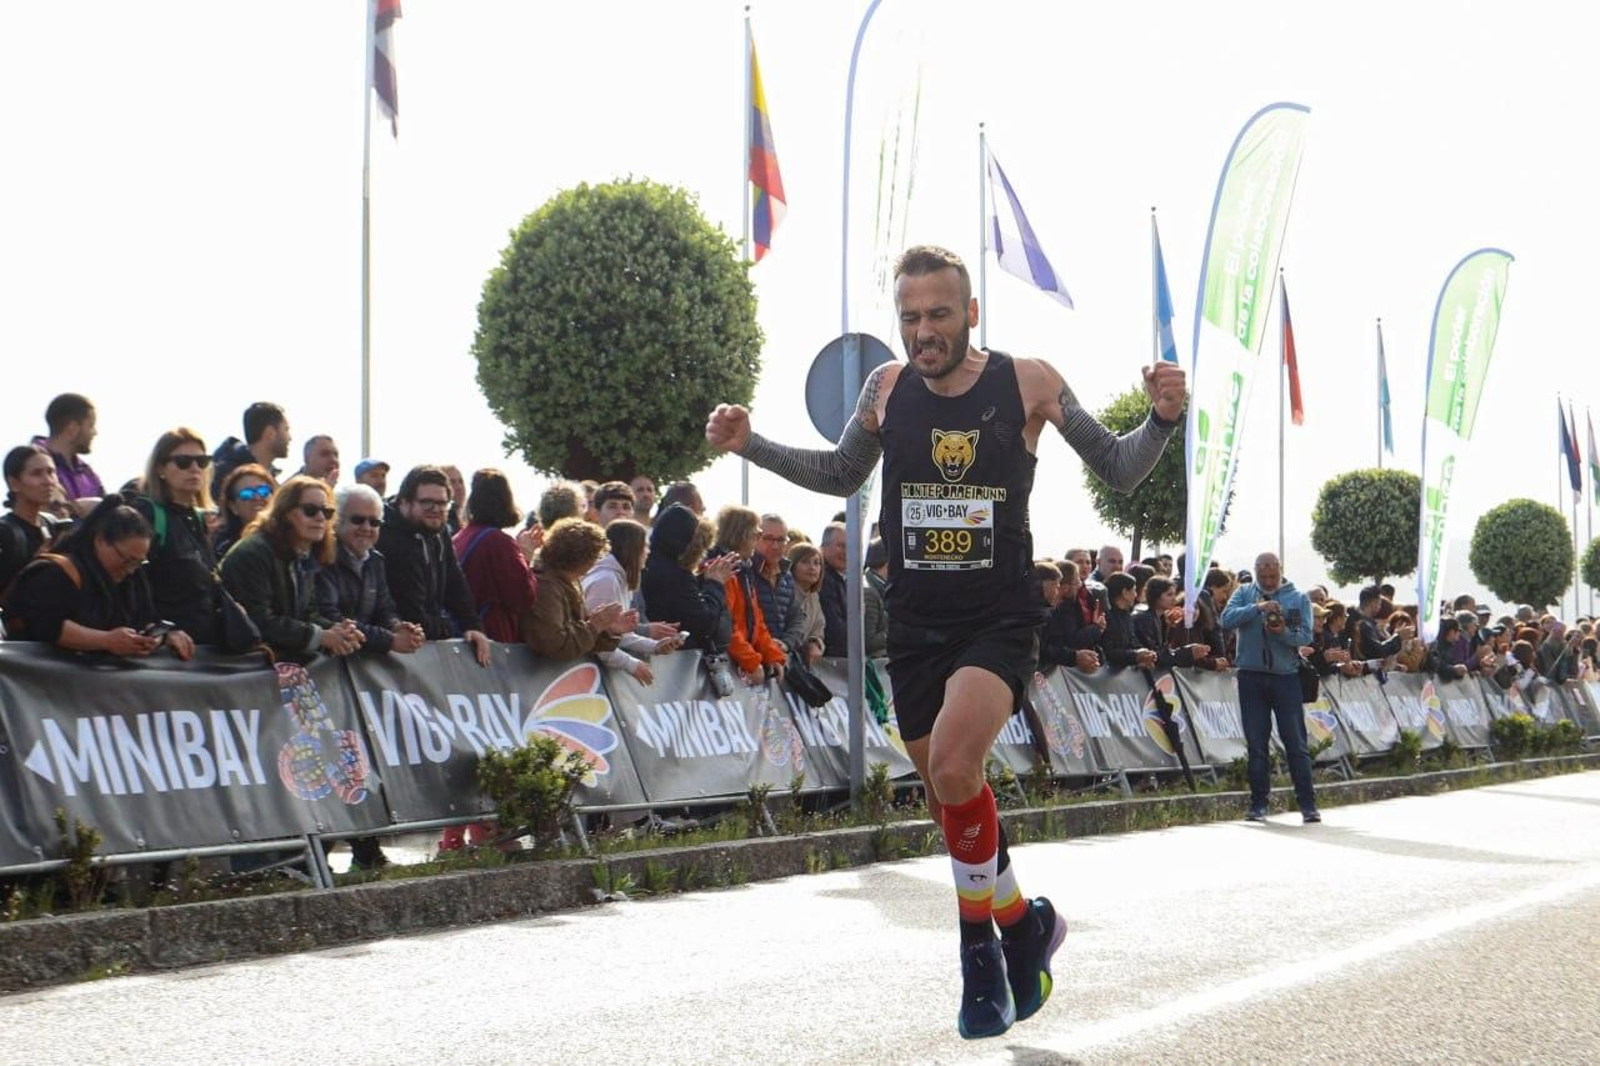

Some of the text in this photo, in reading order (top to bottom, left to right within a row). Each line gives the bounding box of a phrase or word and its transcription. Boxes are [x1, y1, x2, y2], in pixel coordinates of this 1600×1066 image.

[910, 507, 921, 520] 25
[926, 505, 942, 518] VIG
[948, 505, 968, 518] BAY
[925, 530, 972, 553] 389
[637, 700, 759, 758] MINIBAY
[41, 709, 267, 796] MINIBAY
